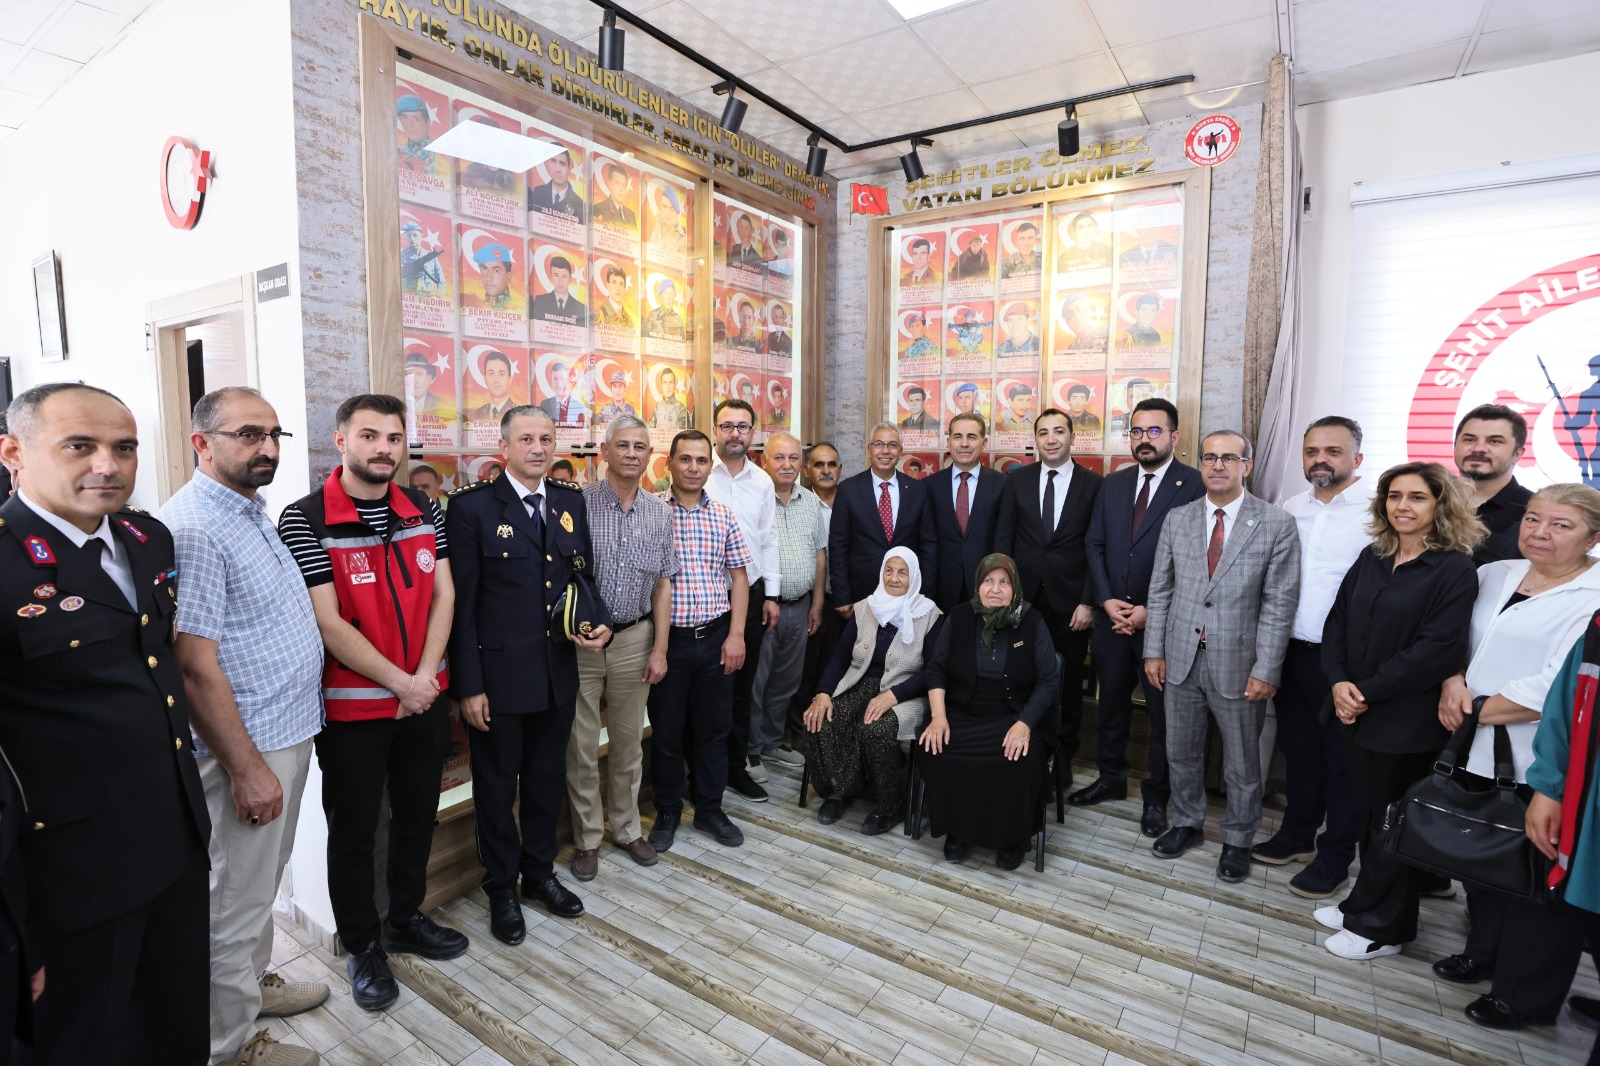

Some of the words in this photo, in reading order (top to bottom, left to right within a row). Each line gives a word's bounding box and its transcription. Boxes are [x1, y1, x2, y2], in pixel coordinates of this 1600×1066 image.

[432, 0, 543, 57] OLUNDA
[463, 34, 545, 90] ONLAR
[662, 124, 709, 162] FAKAT
[901, 186, 983, 212] VATAN
[991, 157, 1156, 198] BÖLÜNMEZ
[904, 156, 1031, 195] ŞEHİTLER
[1434, 308, 1508, 389] ŞEHİT
